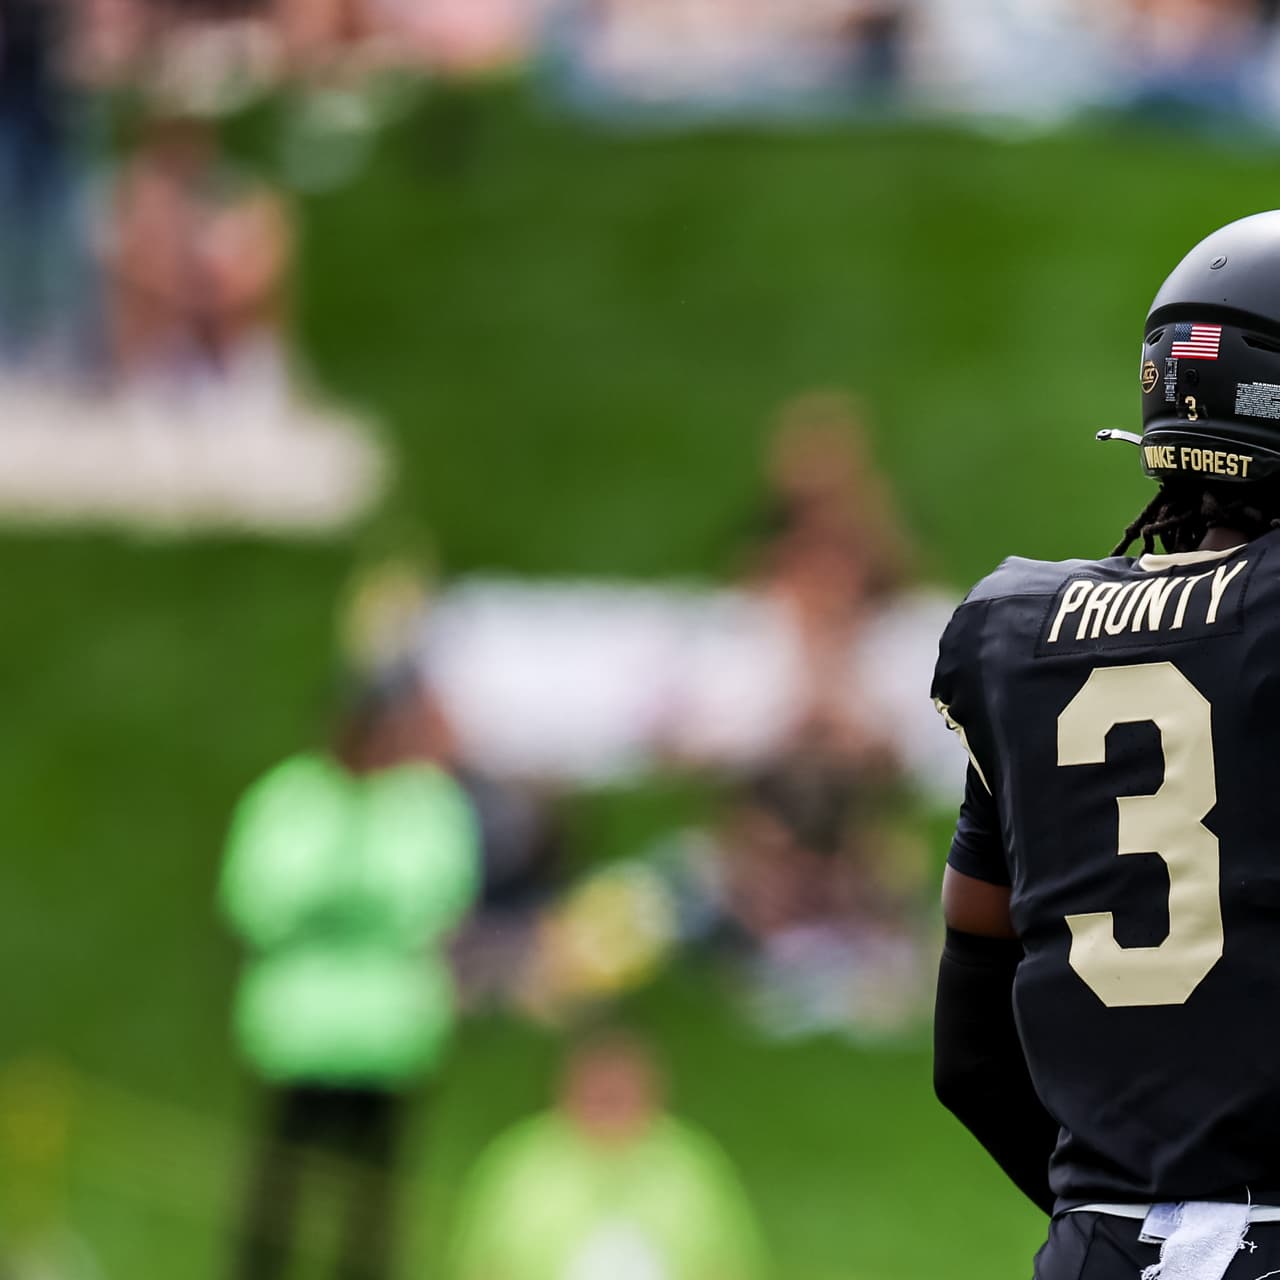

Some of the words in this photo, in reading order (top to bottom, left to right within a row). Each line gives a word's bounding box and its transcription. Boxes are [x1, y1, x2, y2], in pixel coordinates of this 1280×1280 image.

[1184, 395, 1199, 421] 3
[1144, 445, 1177, 469] WAKE
[1181, 447, 1253, 478] FOREST
[1047, 559, 1248, 643] PRUNTY
[1056, 660, 1224, 1007] 3
